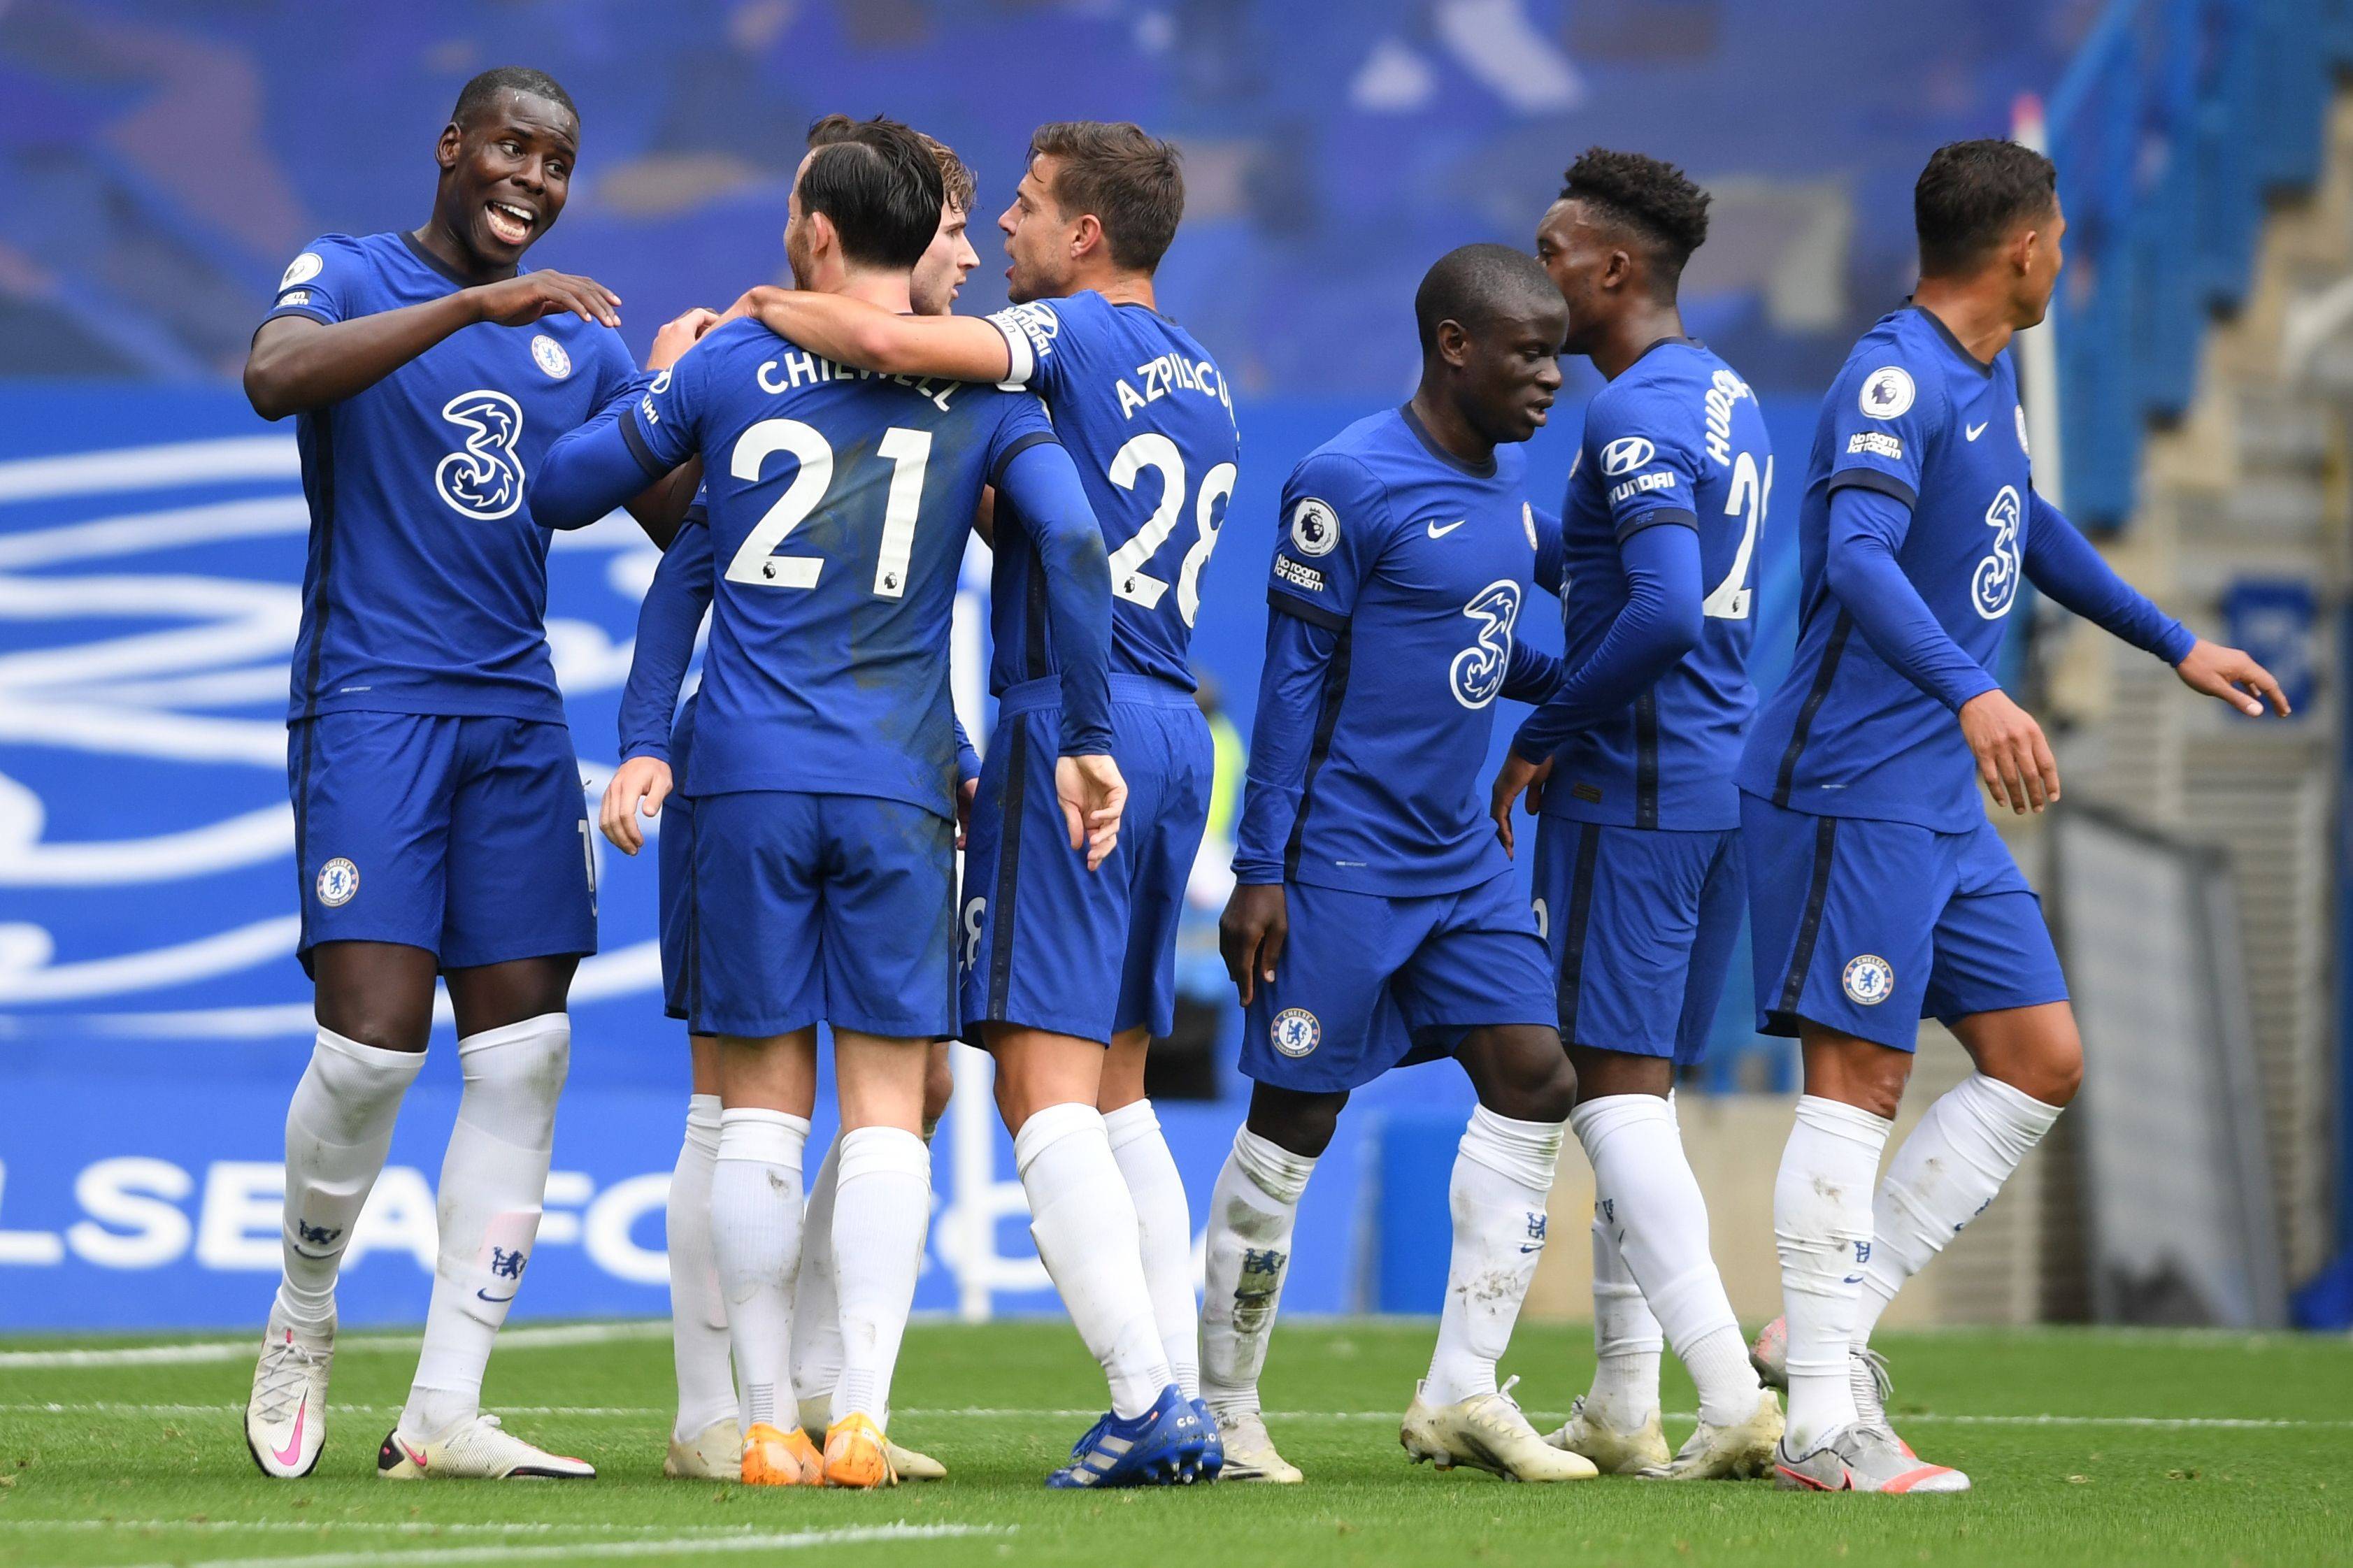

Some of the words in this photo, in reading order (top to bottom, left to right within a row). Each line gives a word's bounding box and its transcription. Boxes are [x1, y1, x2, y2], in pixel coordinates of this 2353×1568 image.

[1850, 433, 1866, 445] No
[1866, 432, 1898, 448] room
[1609, 471, 1675, 507] YUNDAI
[724, 418, 932, 598] 21
[1108, 432, 1238, 628] 28
[1703, 451, 1773, 620] 2
[1273, 566, 1287, 578] for
[1287, 572, 1324, 592] racism
[1278, 553, 1290, 568] No
[1289, 562, 1322, 582] room
[325, 860, 351, 870] CHELSEA
[1857, 958, 1887, 972] CHELSEA
[1283, 1011, 1313, 1023] CHELSEA
